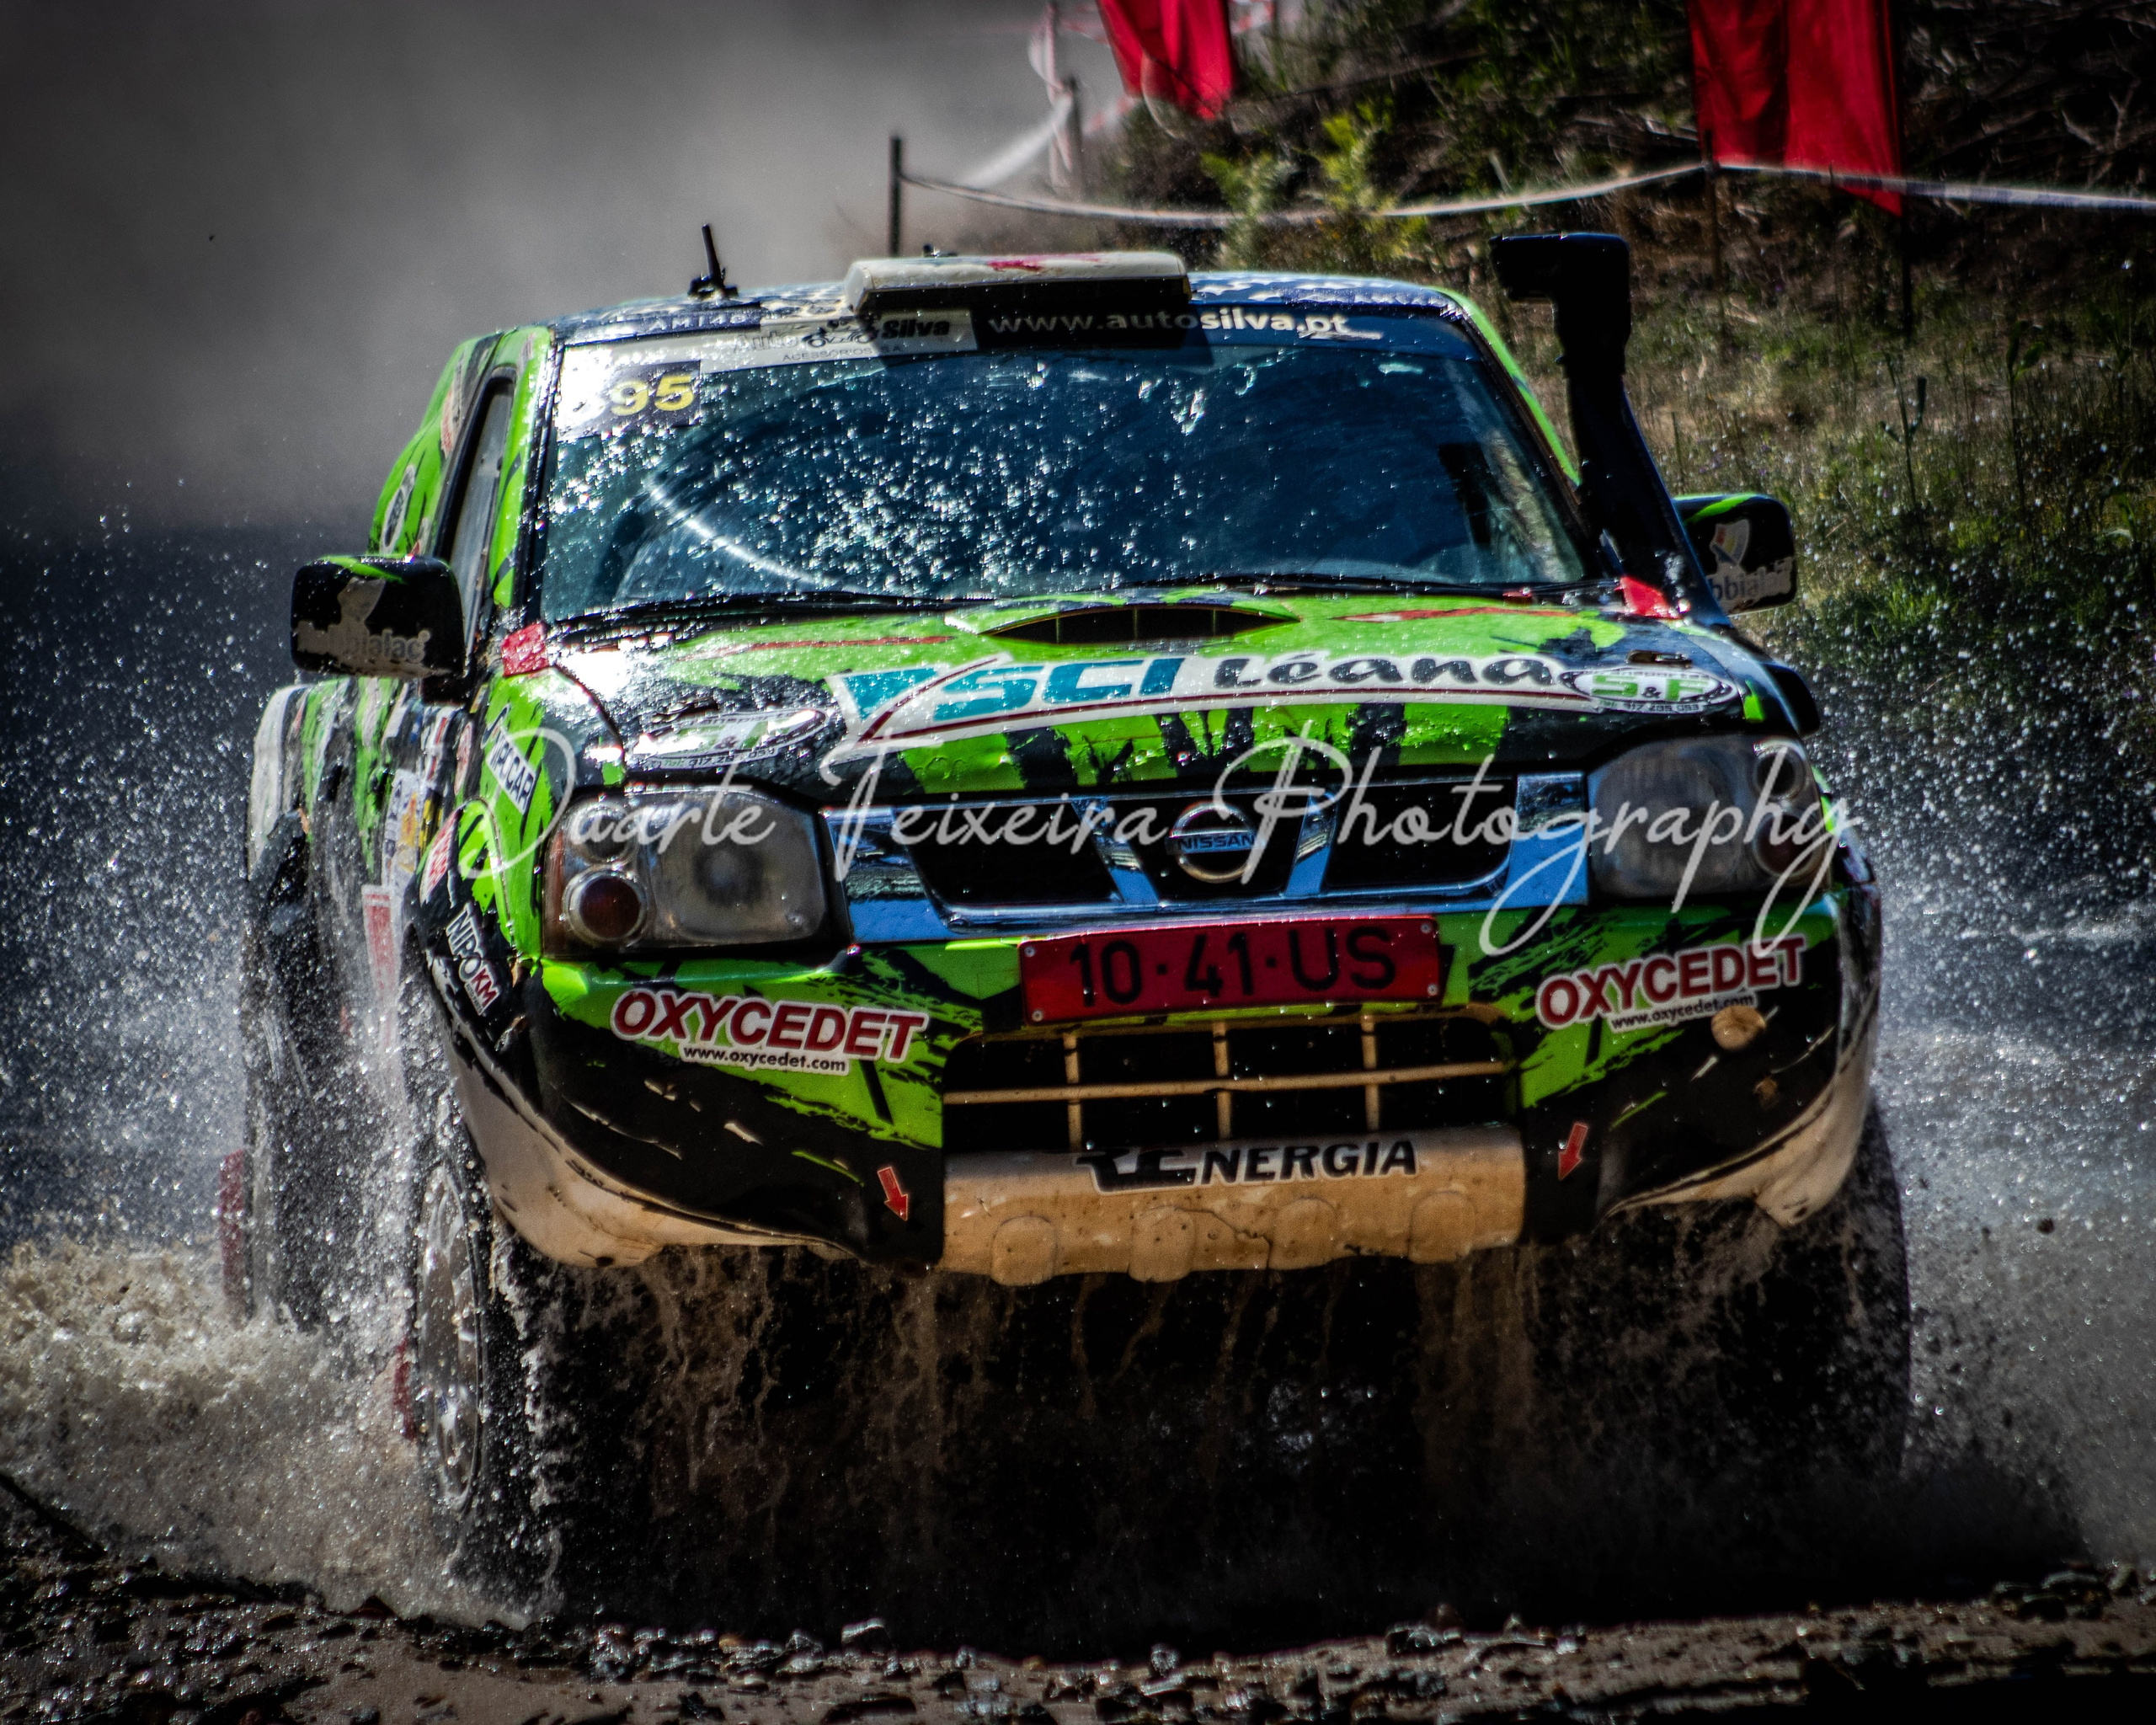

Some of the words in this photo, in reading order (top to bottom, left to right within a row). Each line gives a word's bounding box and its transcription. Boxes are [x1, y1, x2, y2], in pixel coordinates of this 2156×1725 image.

[883, 318, 950, 338] Silva
[988, 307, 1349, 339] www.autosilva.pt
[1179, 834, 1255, 850] NISSAN
[1540, 937, 1805, 1025] OXYCEDET
[613, 991, 925, 1060] OXYCEDET
[1611, 994, 1754, 1030] www.oxycedet.com
[683, 1045, 846, 1072] www.oxycedet.com
